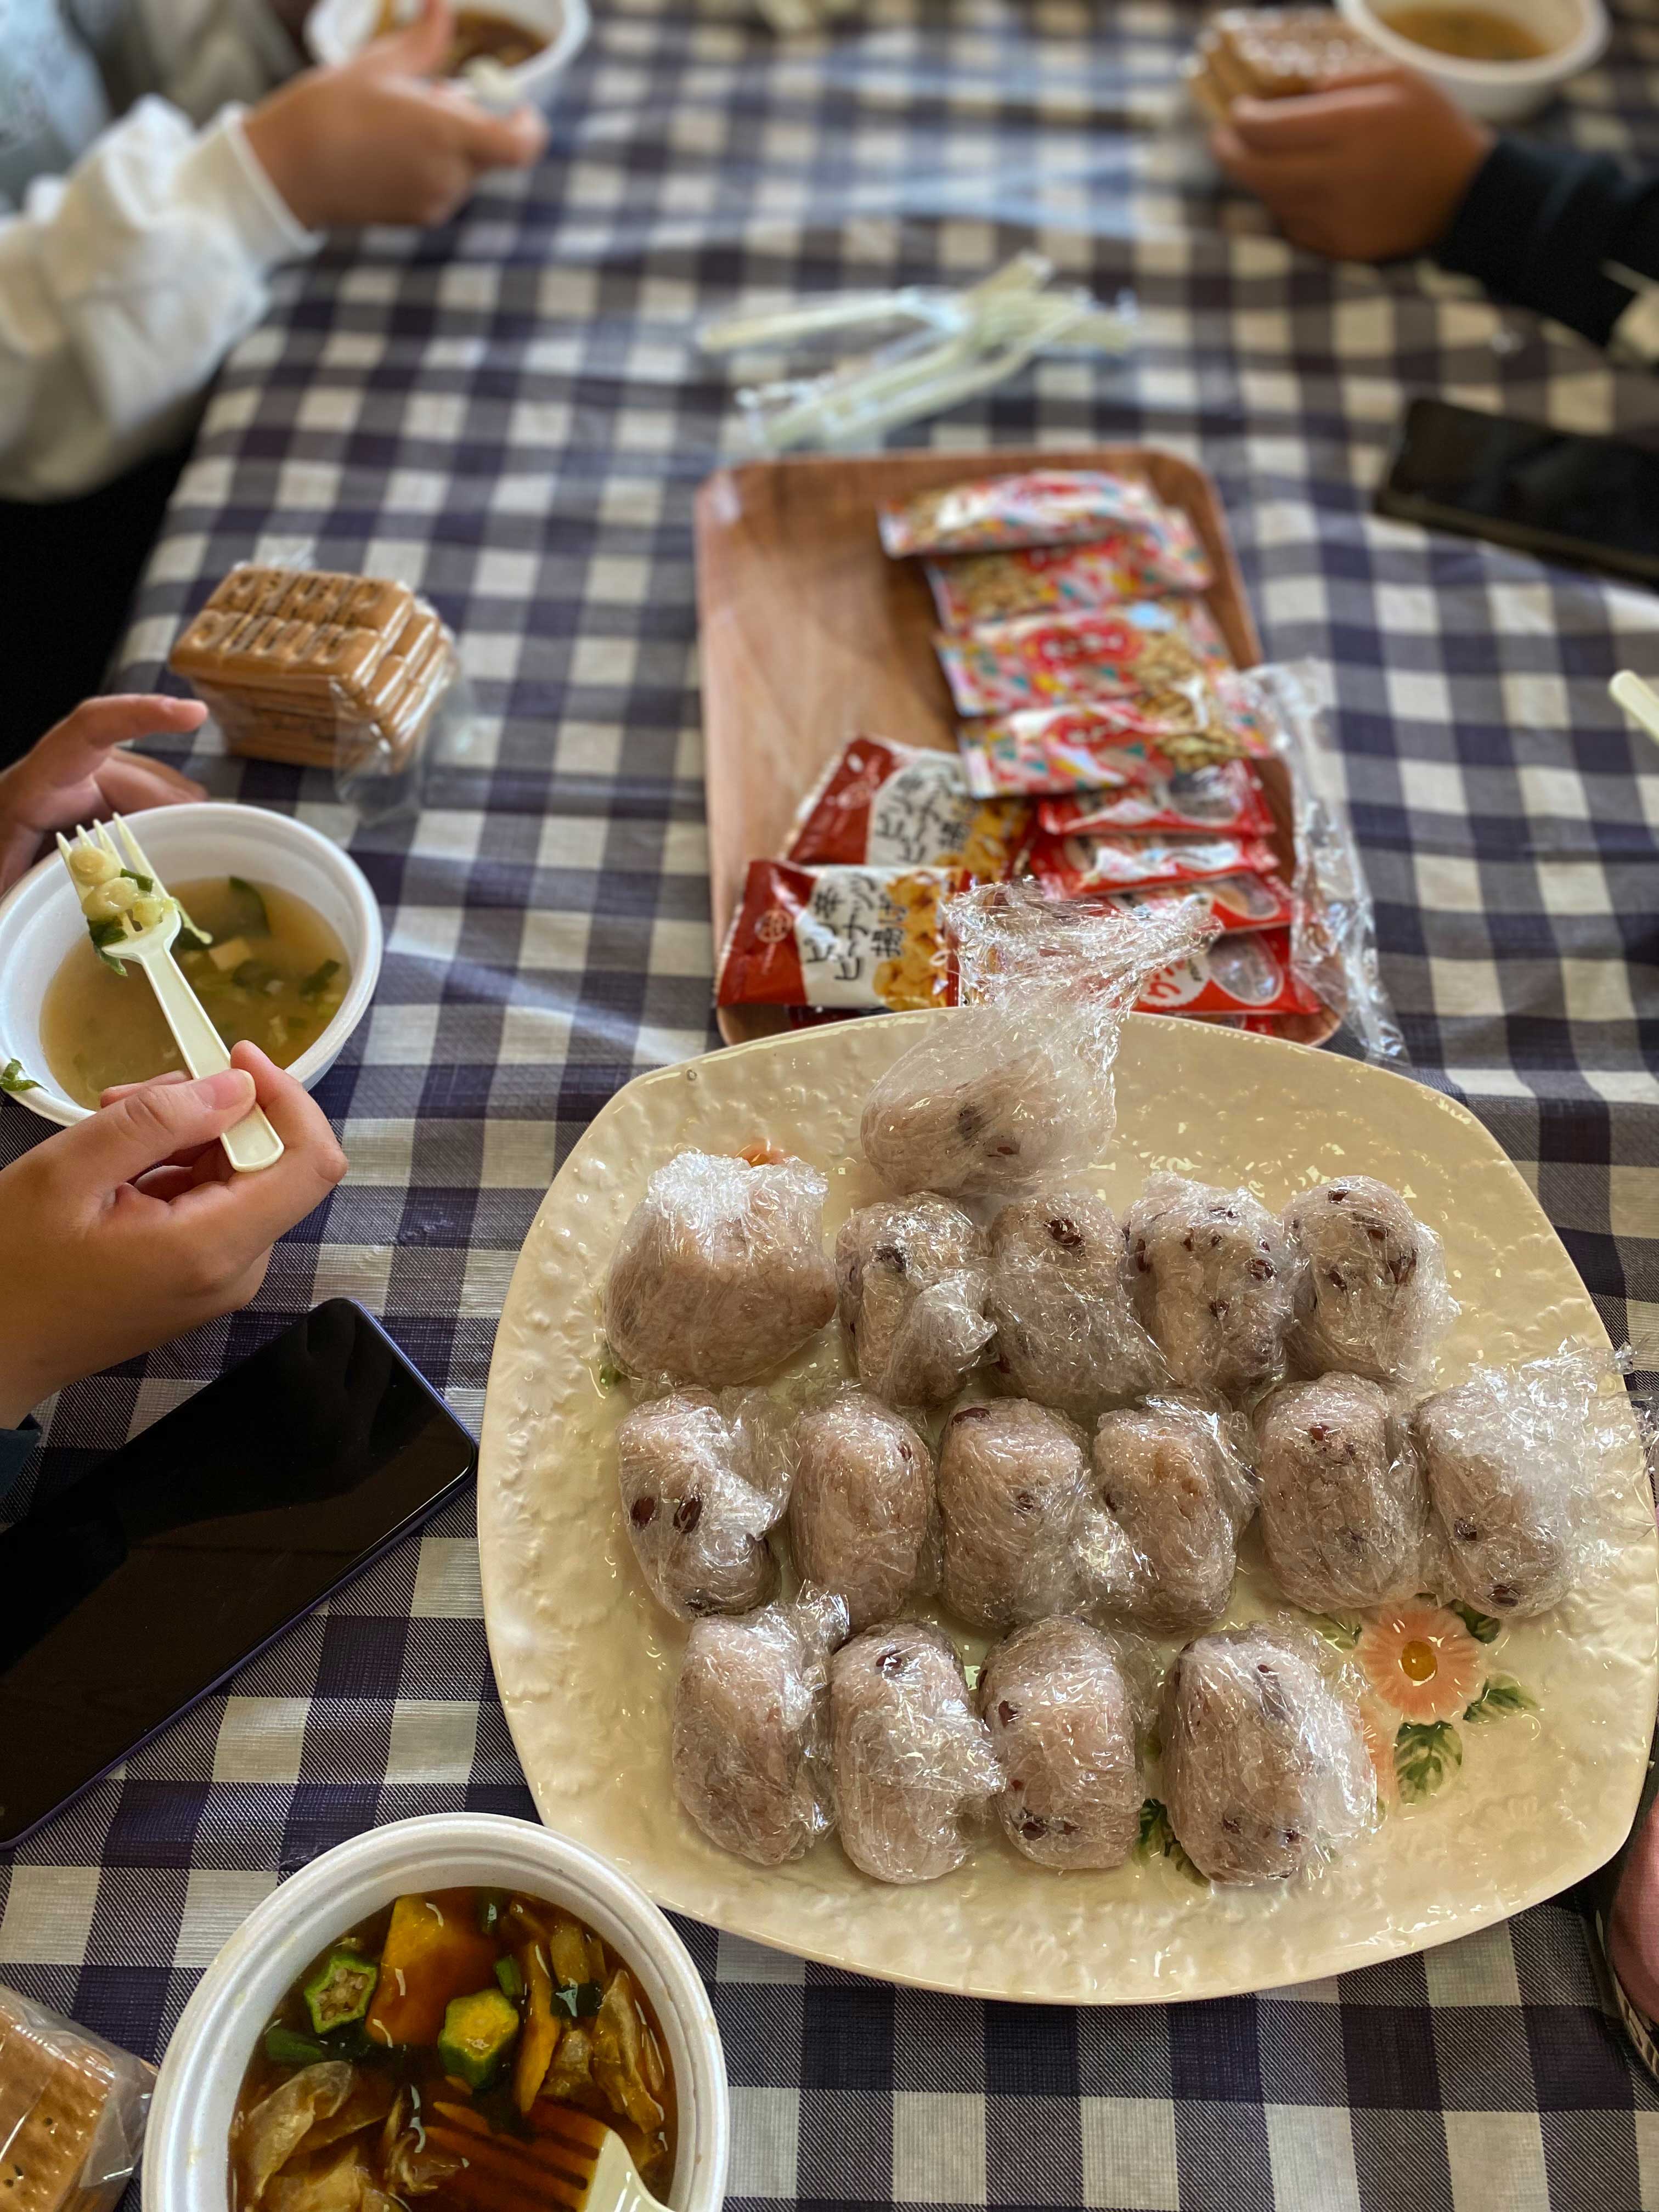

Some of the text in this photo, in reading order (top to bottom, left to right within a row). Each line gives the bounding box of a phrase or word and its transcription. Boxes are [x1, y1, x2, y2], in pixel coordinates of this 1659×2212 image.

[834, 873, 876, 980] ピーナッツ
[871, 893, 907, 957] 揚げ
